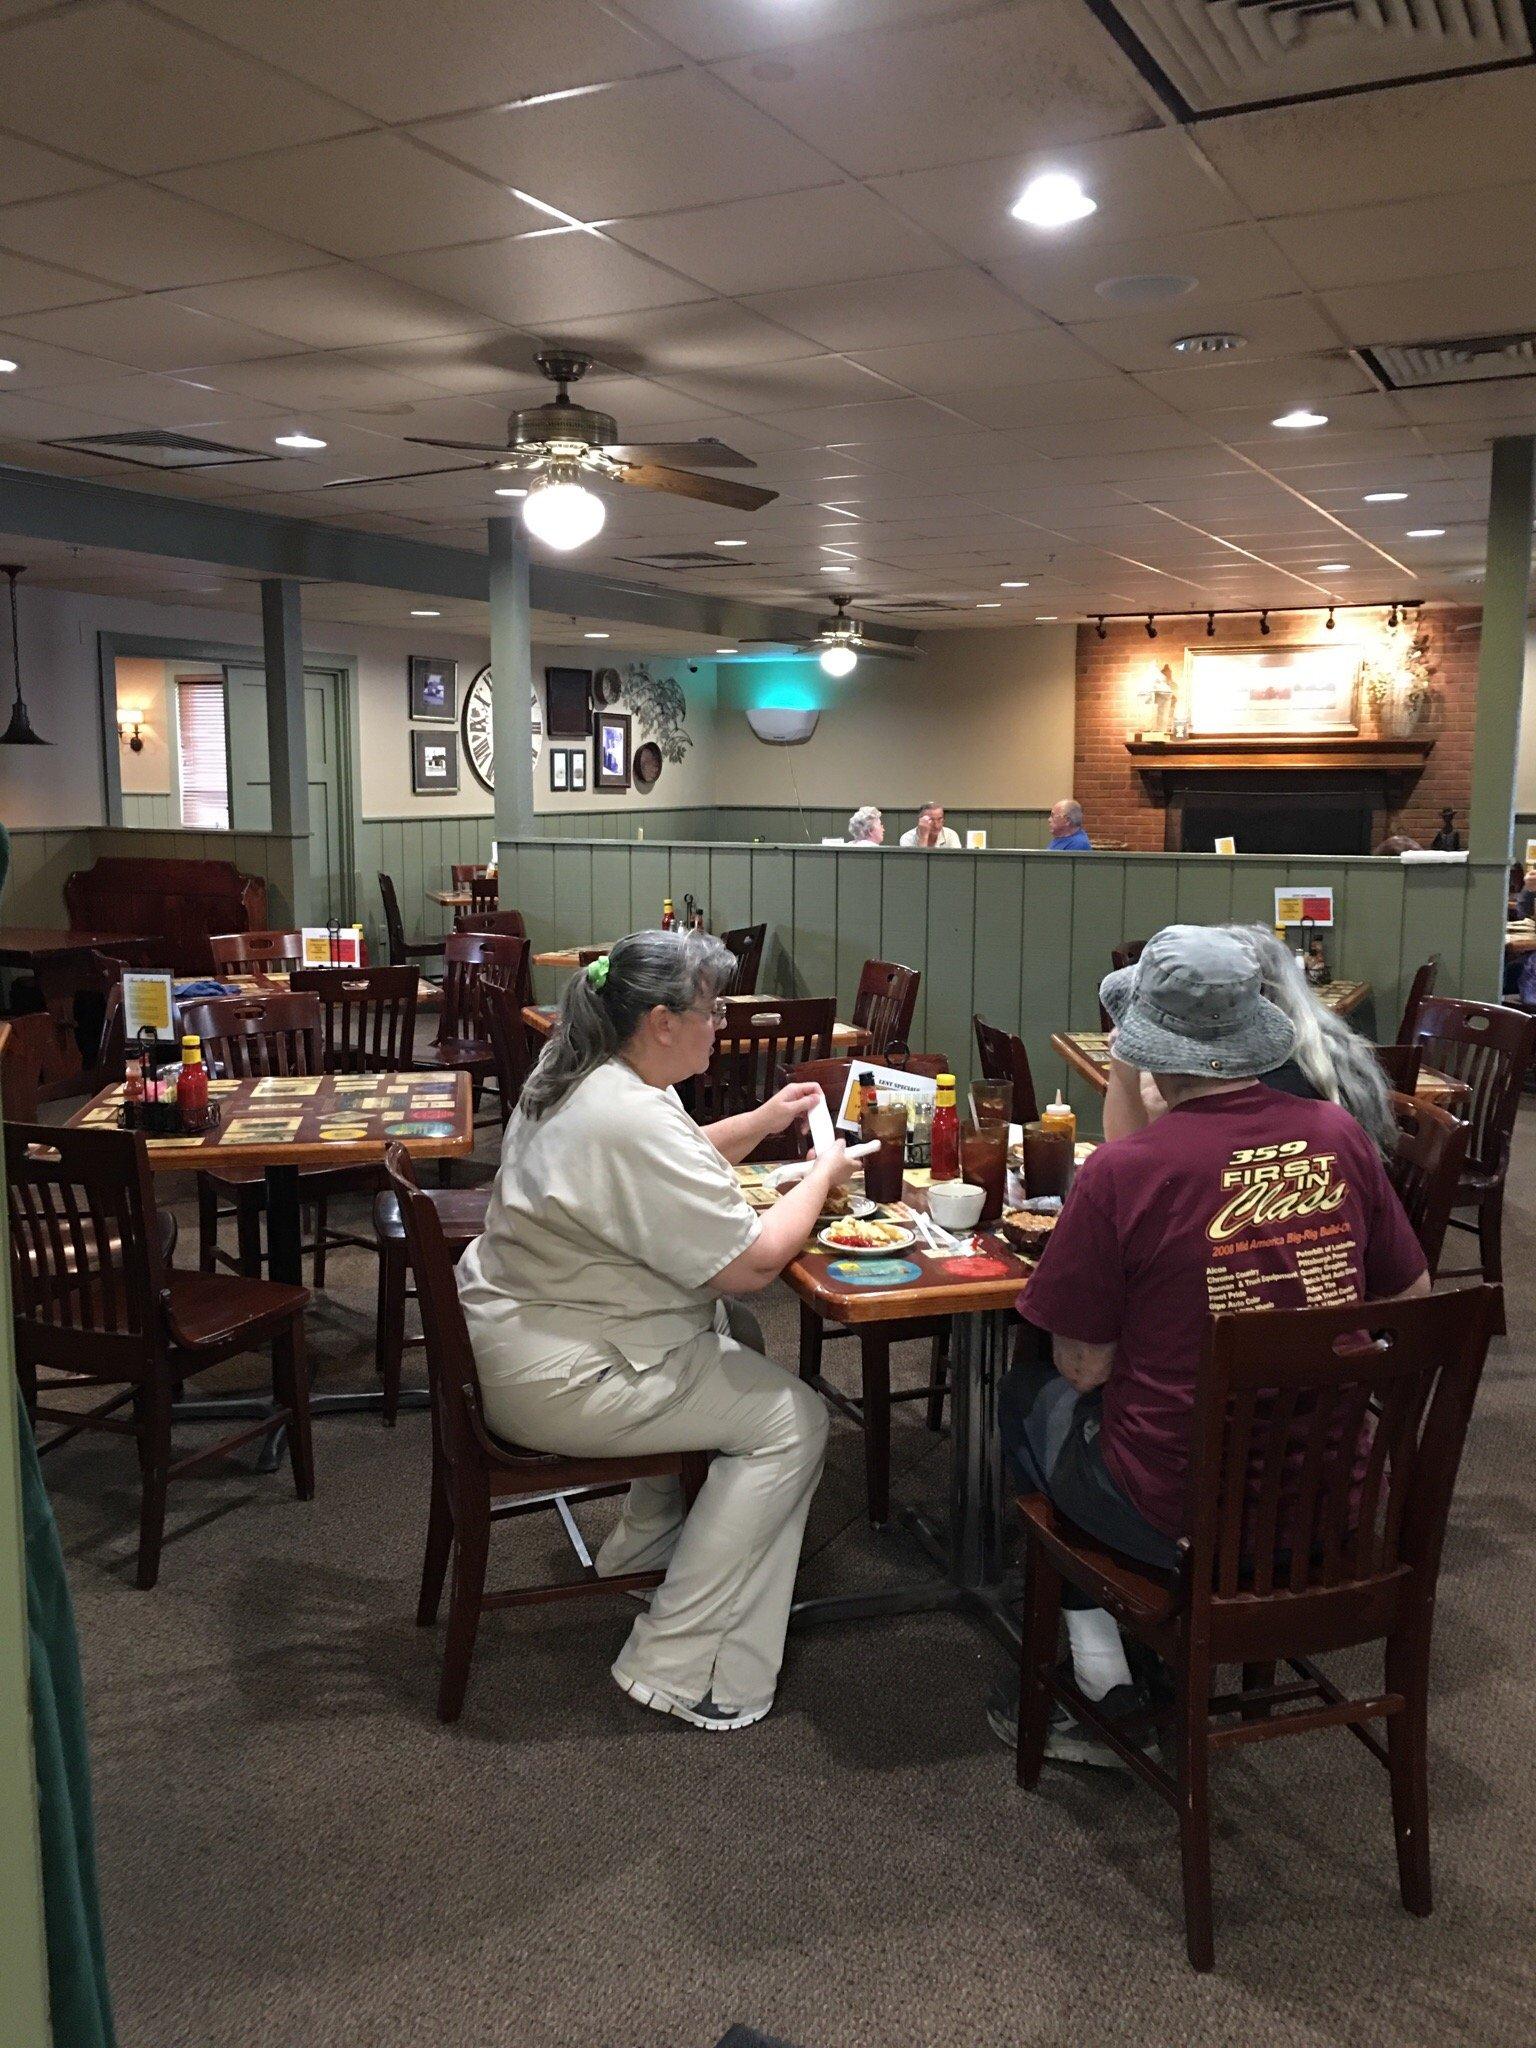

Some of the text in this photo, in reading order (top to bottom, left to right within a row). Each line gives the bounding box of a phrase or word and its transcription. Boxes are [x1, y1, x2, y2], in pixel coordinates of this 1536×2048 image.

[878, 1079, 893, 1087] LENT
[1229, 1140, 1308, 1165] 359
[1223, 1154, 1336, 1189] FIRST
[1298, 1171, 1330, 1190] IN
[1208, 1182, 1347, 1240] Class
[1206, 1269, 1259, 1284] Chrome Country
